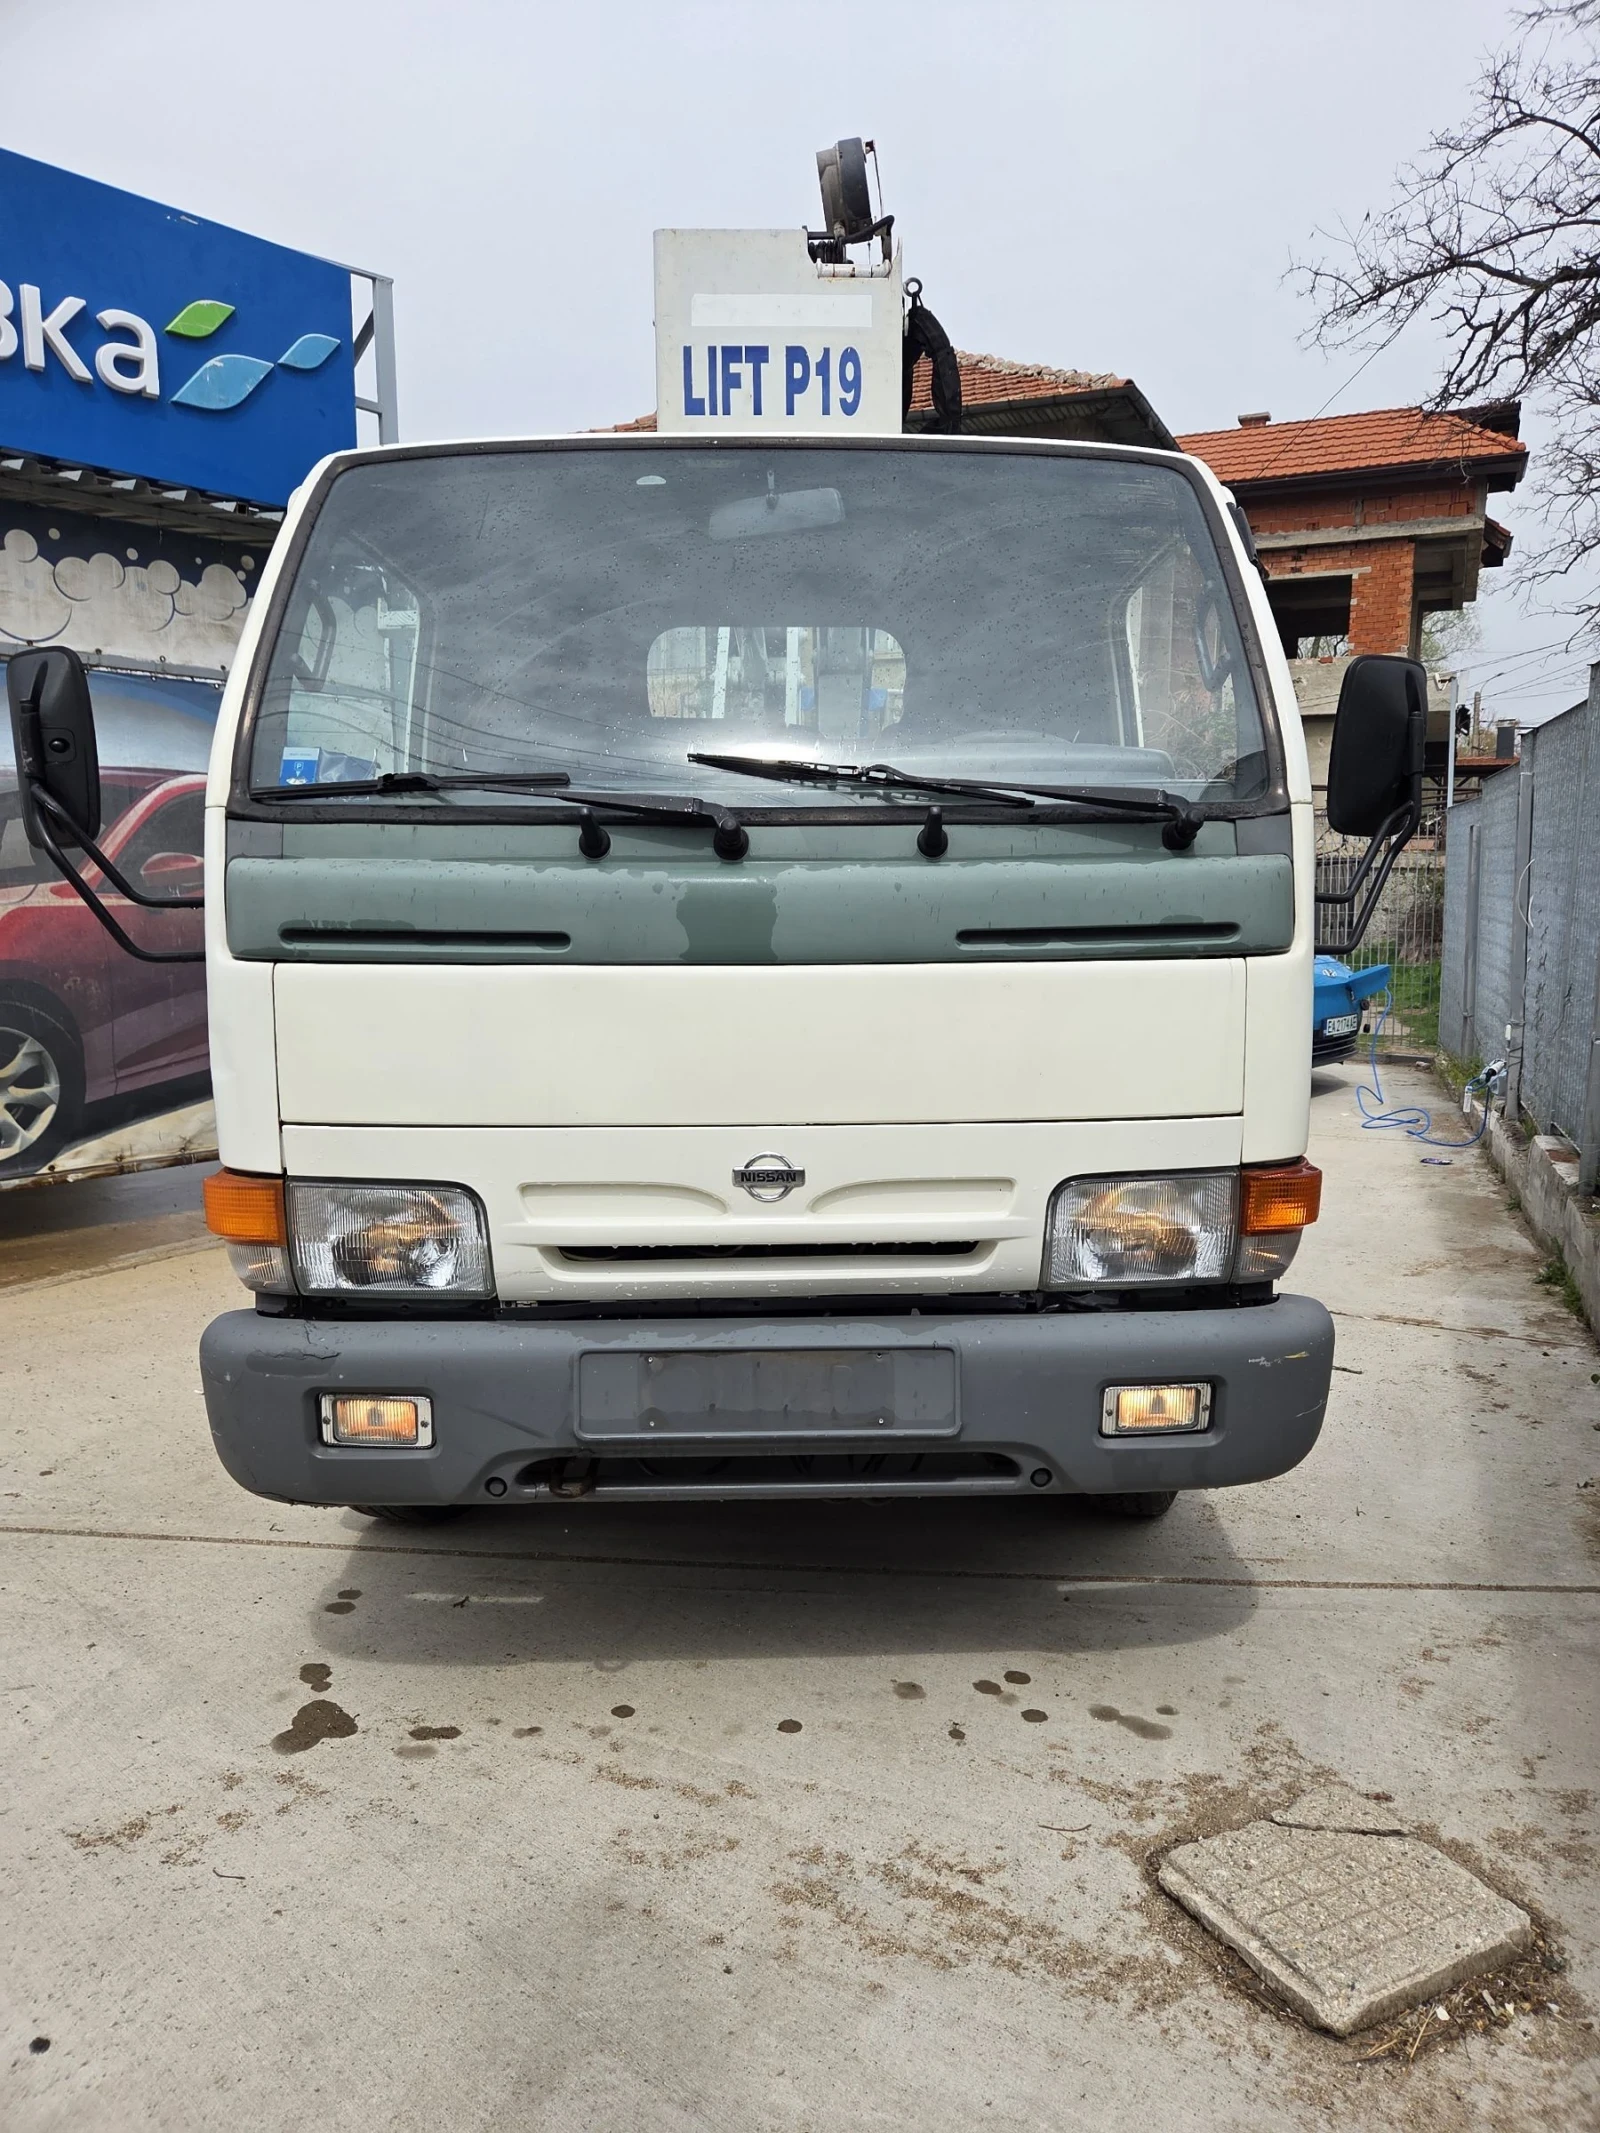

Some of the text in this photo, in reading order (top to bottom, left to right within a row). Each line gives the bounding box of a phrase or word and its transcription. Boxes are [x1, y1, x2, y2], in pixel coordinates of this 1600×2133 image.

[683, 345, 862, 417] LIFT P19
[741, 1172, 797, 1182] NISSAN
